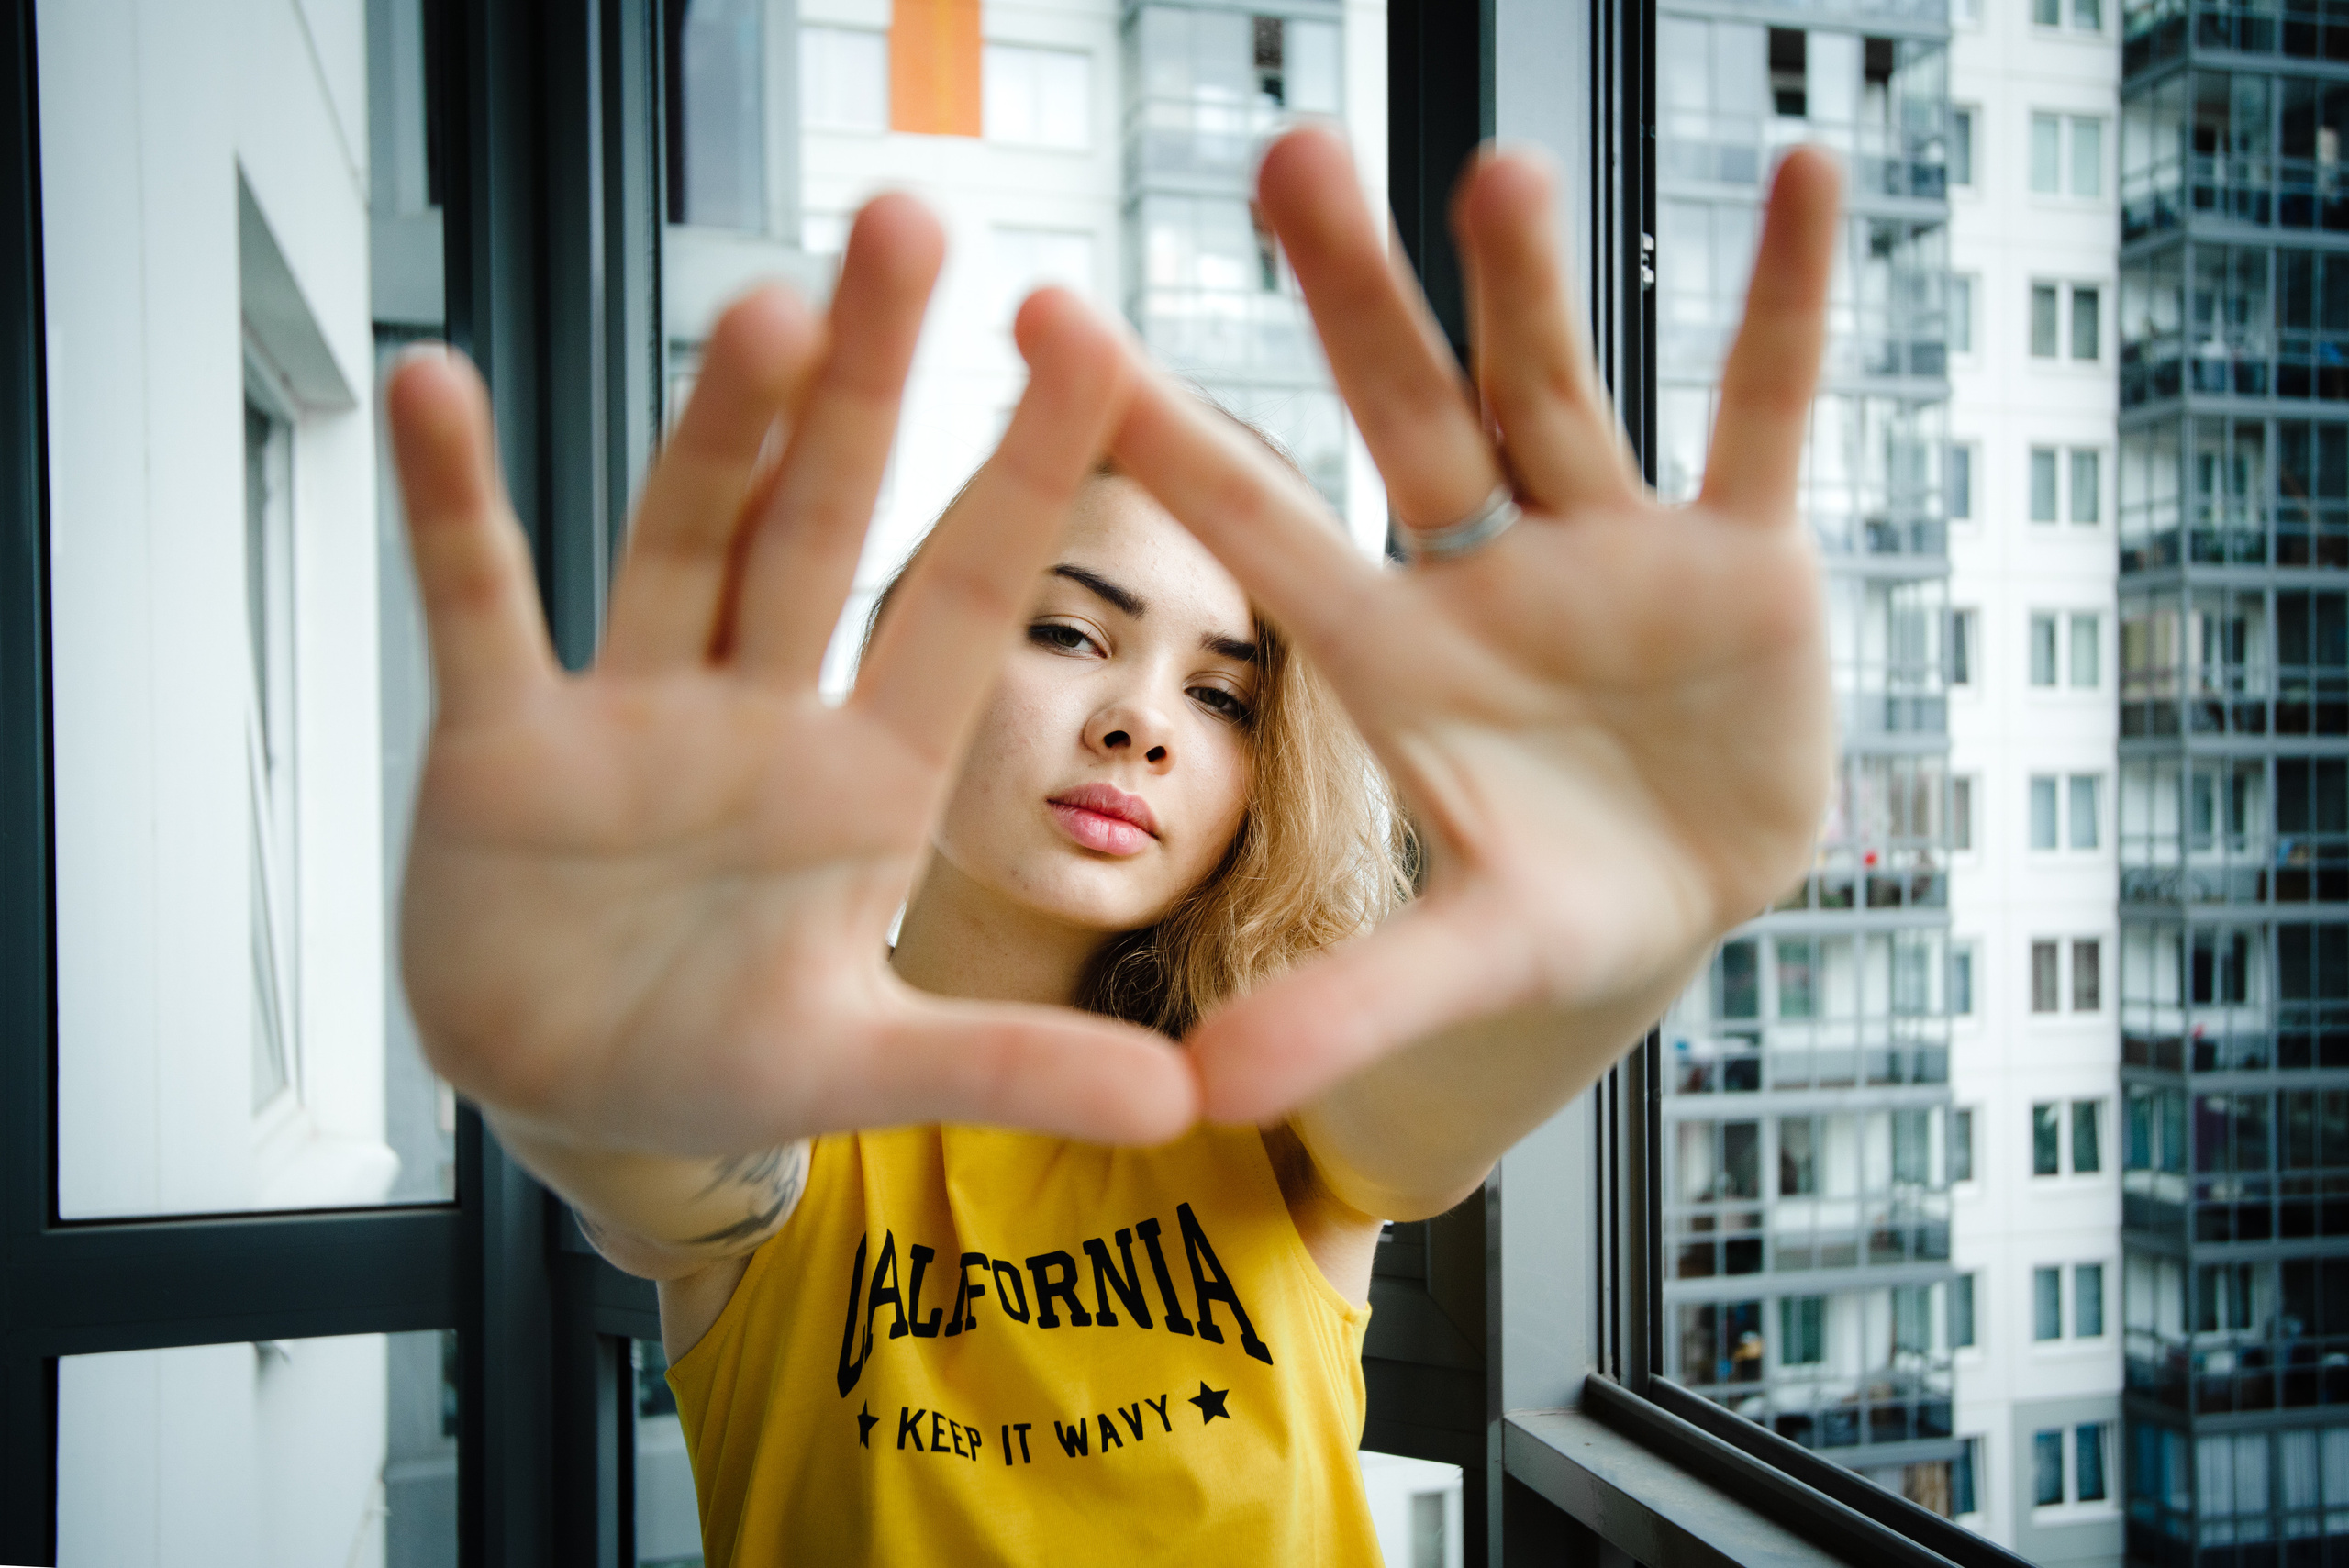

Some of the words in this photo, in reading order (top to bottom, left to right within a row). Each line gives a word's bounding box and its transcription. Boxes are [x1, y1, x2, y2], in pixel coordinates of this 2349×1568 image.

[896, 1406, 983, 1462] KEEP
[1001, 1422, 1032, 1466] IT
[1053, 1394, 1173, 1459] WAVY
